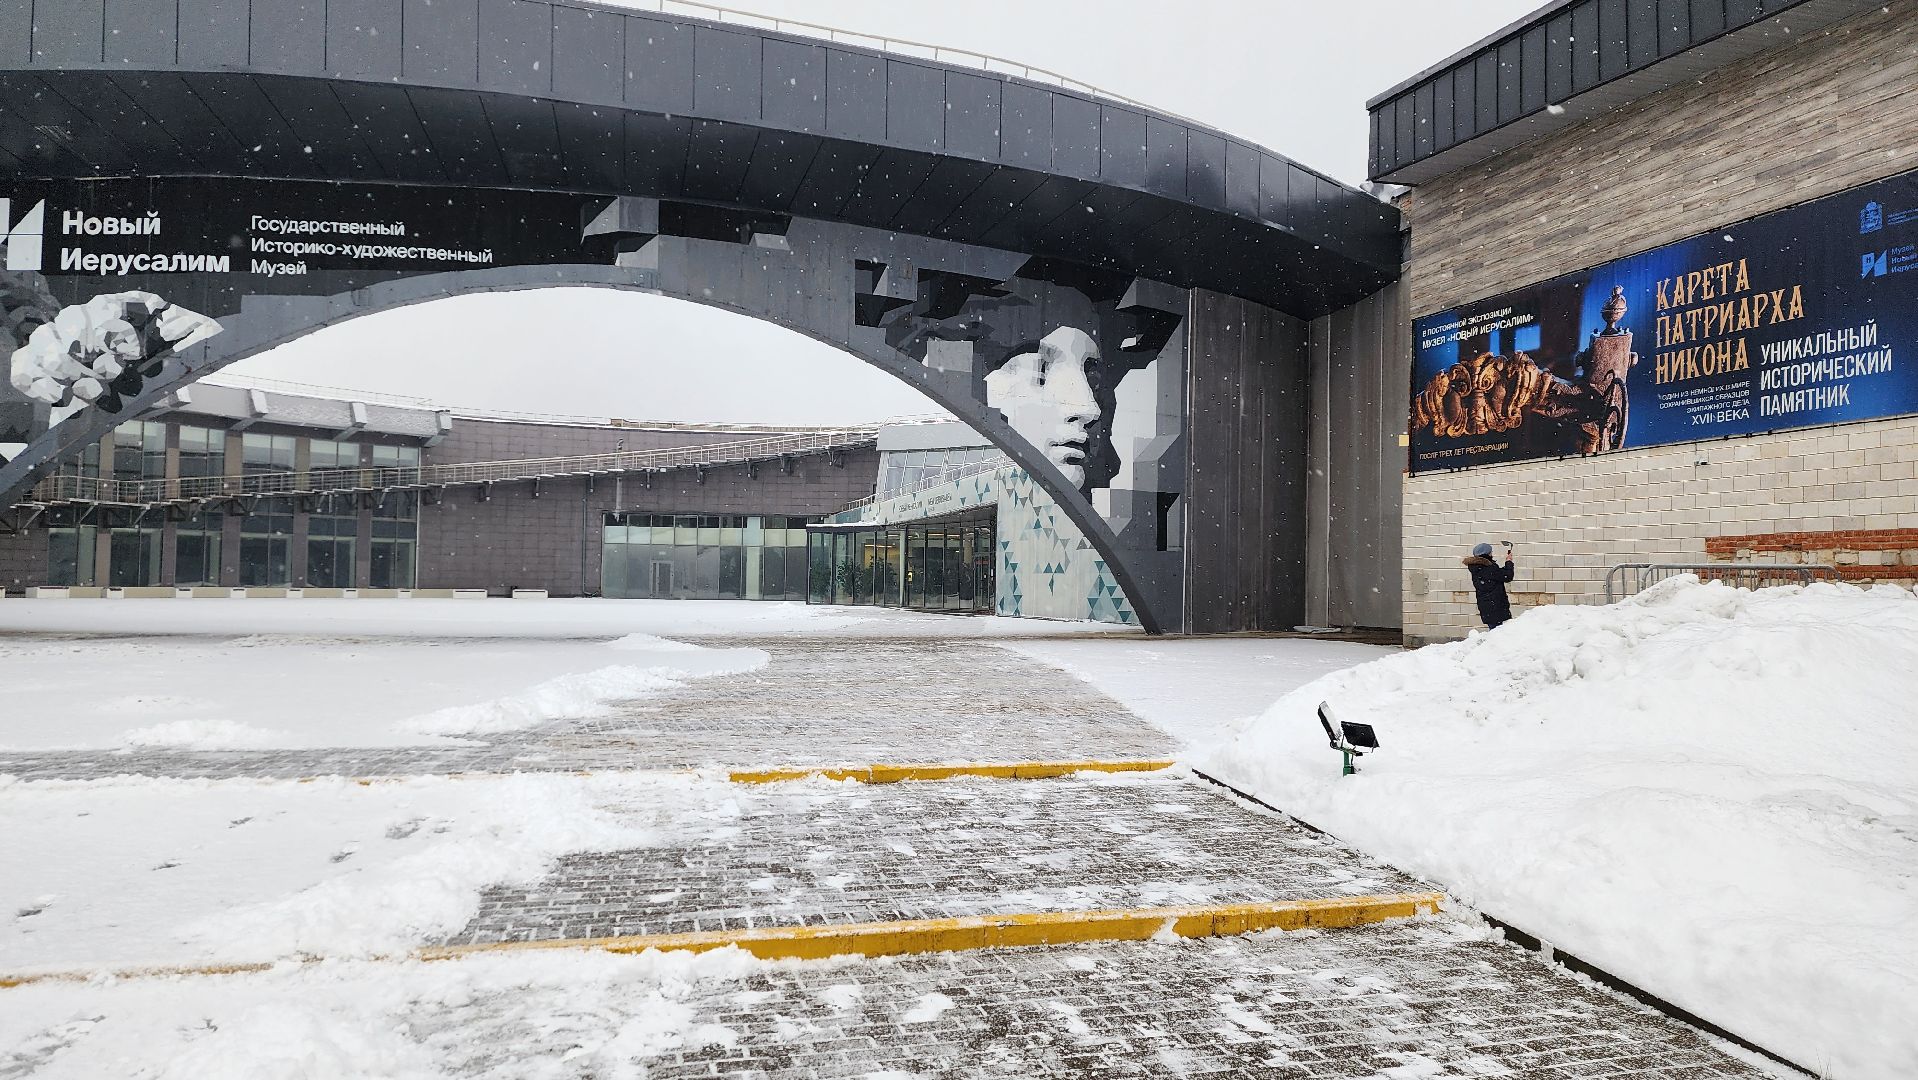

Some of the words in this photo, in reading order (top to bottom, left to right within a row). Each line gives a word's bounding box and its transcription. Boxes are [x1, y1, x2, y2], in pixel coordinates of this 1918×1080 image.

[62, 210, 161, 235] Новый
[251, 215, 405, 236] Государственный
[60, 247, 230, 276] Иерусалим
[251, 238, 493, 263] Историко-художественный
[251, 259, 307, 278] Музей
[1656, 258, 1751, 312] КАРЕТА
[1427, 317, 1467, 336] ПОСТОЯННОЙ
[1468, 306, 1512, 325] ЭКСПОЗИЦИИ
[1656, 285, 1805, 349] ПАТРИАРХА
[1422, 335, 1446, 350] МУЗЕЯ
[1761, 318, 1877, 365] УНИКАЛЬНЫЙ
[1655, 337, 1751, 385] НИКОНА
[1760, 344, 1892, 391] ИСТОРИЧЕСКИЙ
[1661, 392, 1680, 401] ОДИН
[1731, 380, 1750, 390] МИРЕ
[1760, 383, 1850, 417] ПАМЯТНИК
[1716, 407, 1750, 423] ВЕКА
